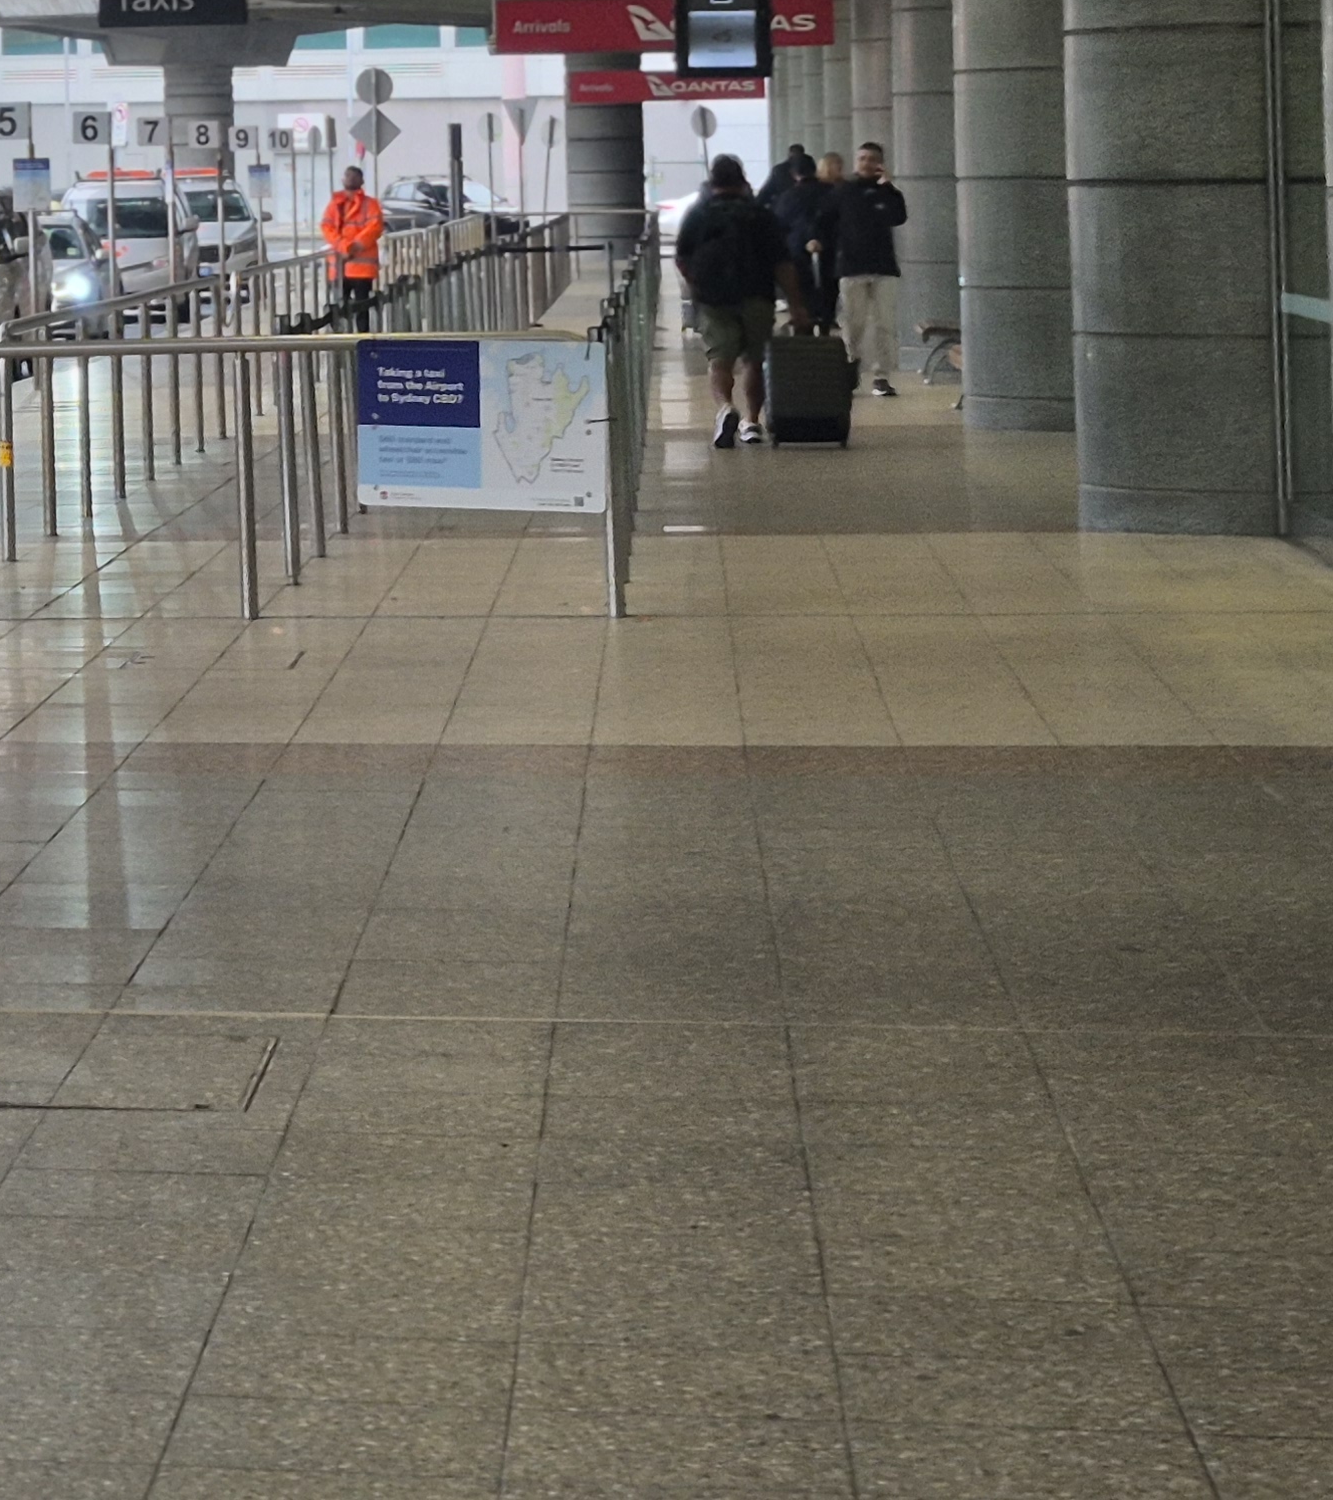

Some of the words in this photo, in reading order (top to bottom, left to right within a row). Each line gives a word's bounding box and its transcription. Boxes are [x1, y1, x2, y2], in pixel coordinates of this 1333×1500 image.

[671, 80, 756, 93] QANTAS
[80, 115, 99, 142] 6
[143, 120, 160, 143] 7
[195, 124, 210, 145] 8
[235, 128, 250, 149] 9
[268, 130, 290, 149] 10
